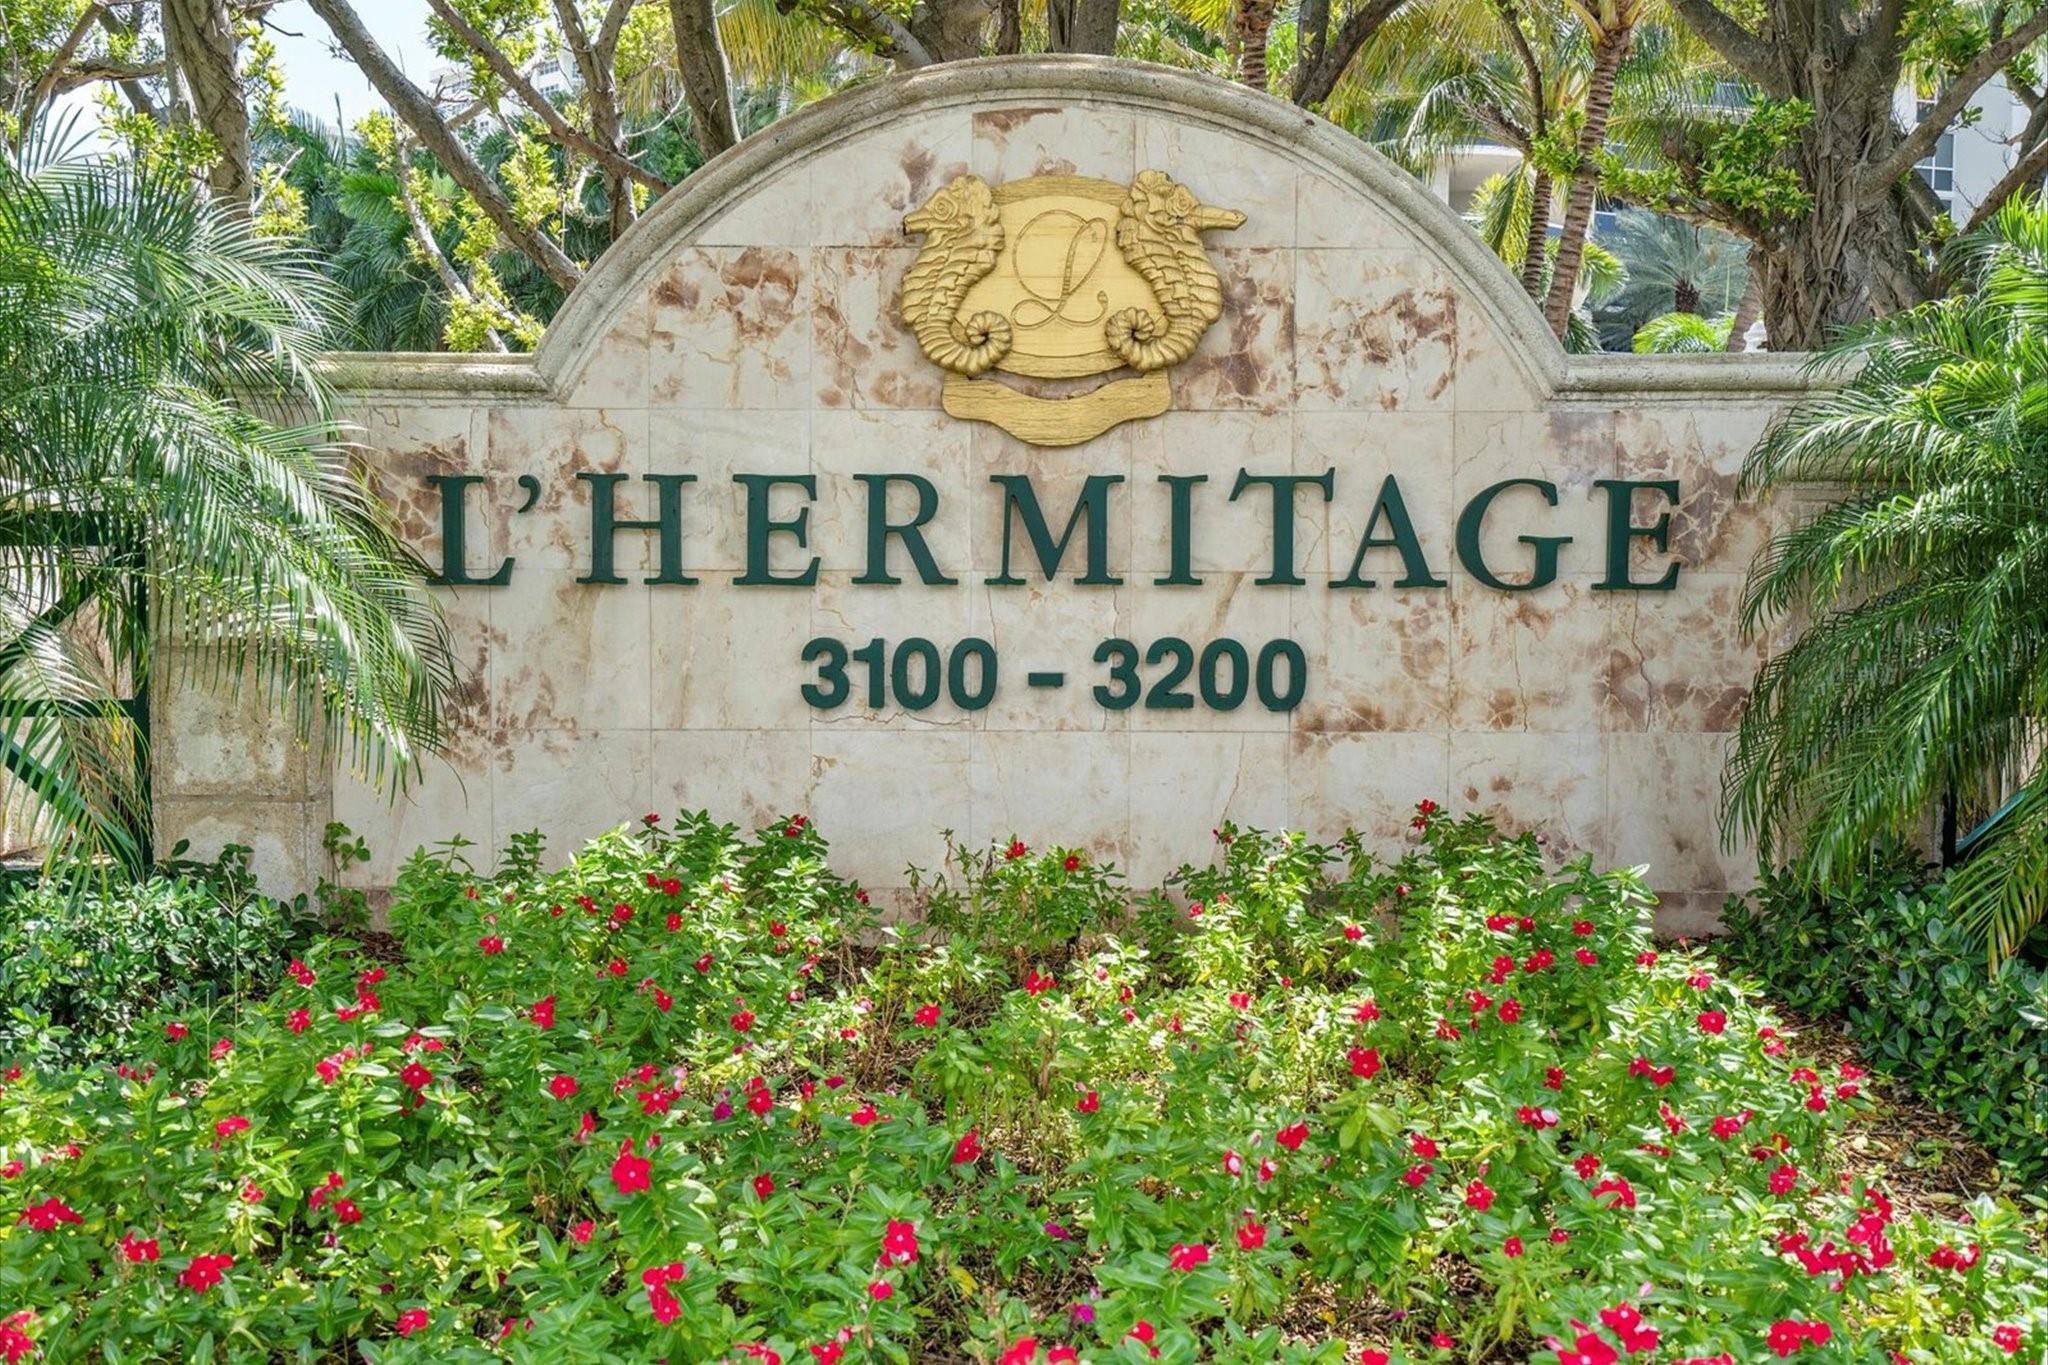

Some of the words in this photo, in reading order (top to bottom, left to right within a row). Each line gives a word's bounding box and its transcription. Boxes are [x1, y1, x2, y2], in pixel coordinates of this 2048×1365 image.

[426, 467, 1681, 590] L'HERMITAGE
[801, 637, 998, 712] 3100
[1028, 672, 1064, 688] -
[1093, 639, 1307, 713] 3200
